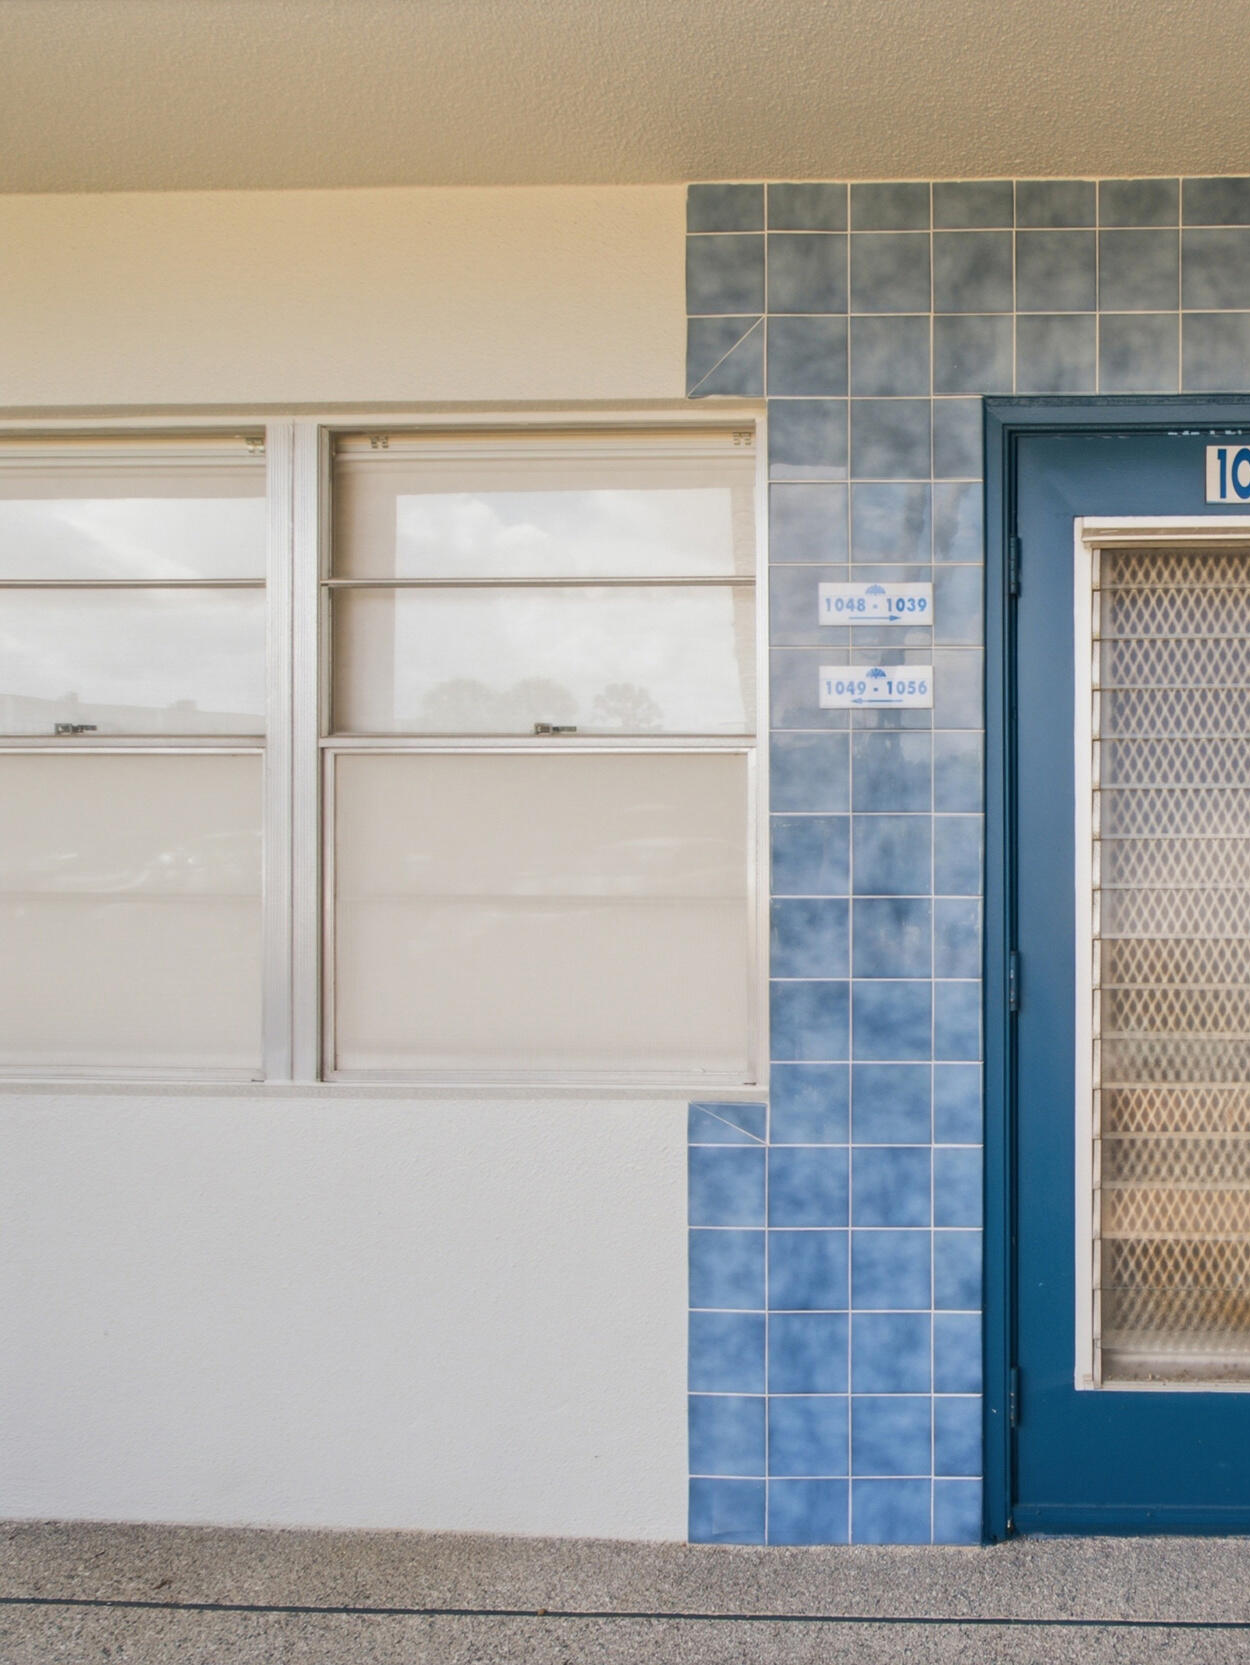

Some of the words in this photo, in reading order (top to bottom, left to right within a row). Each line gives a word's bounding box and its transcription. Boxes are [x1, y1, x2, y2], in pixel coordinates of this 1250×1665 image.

[825, 597, 866, 612] 1048
[886, 597, 928, 612] 1039
[825, 680, 867, 695] 1049
[886, 680, 928, 695] 1056
